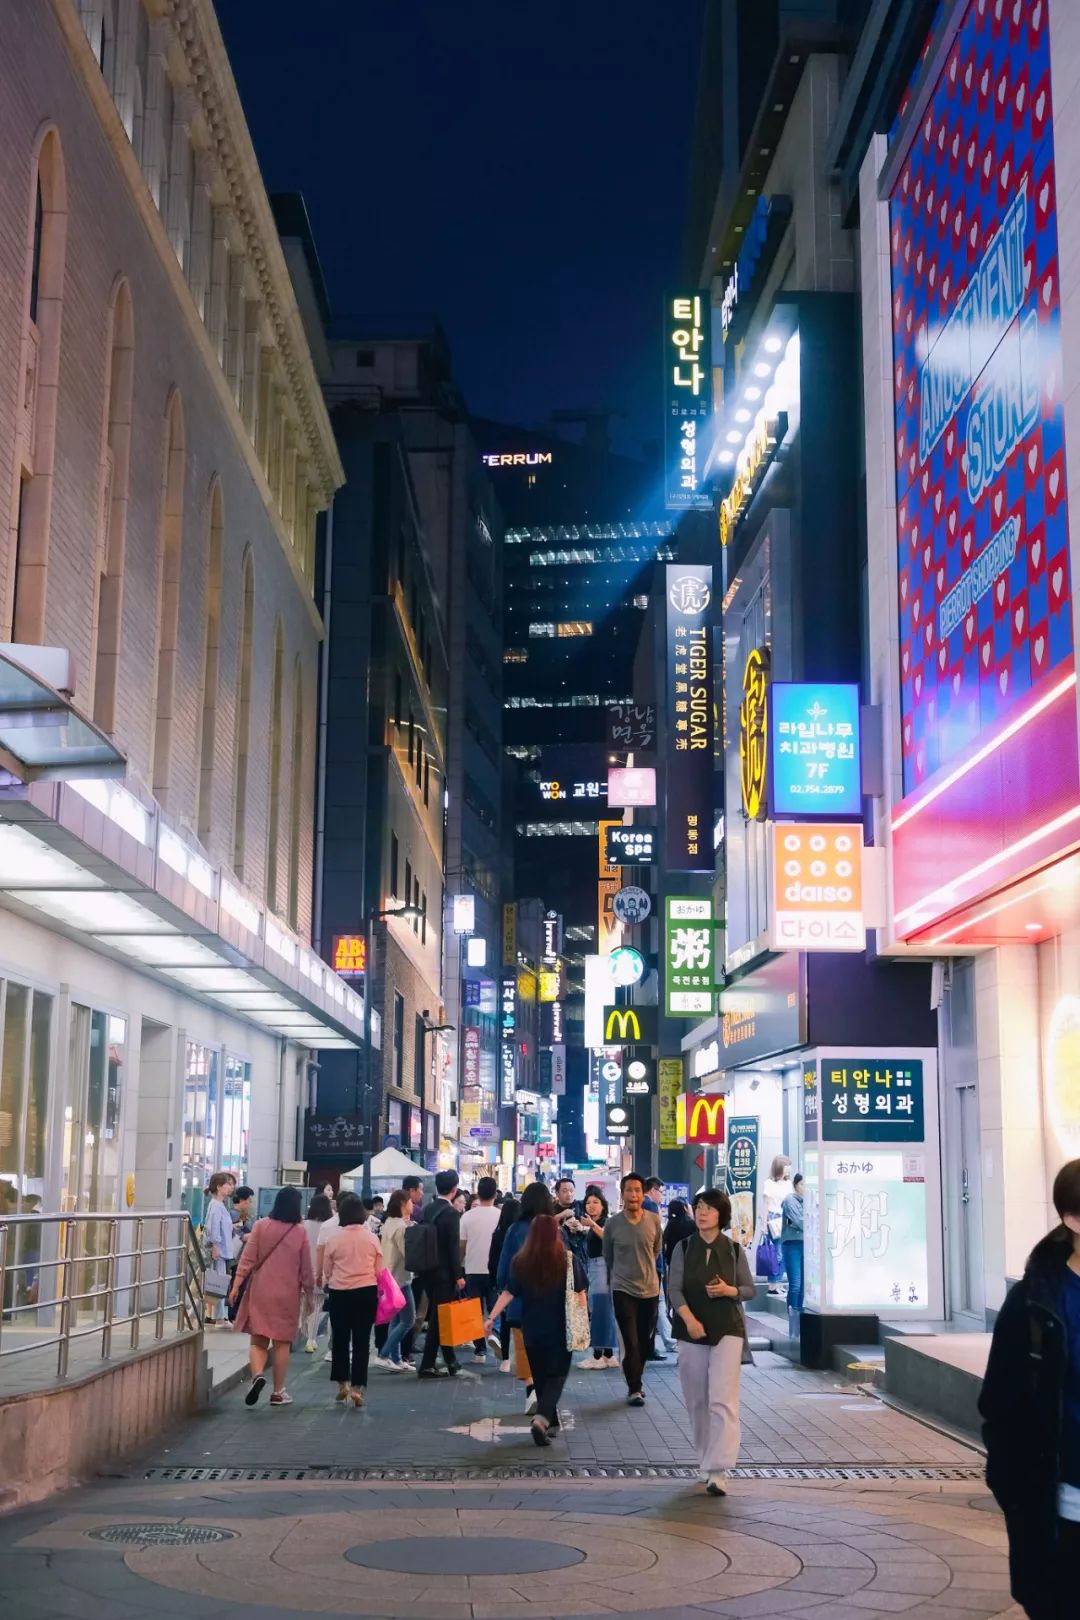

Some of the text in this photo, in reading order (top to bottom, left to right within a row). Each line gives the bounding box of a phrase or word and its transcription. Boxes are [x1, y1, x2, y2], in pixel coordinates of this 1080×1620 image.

[672, 295, 705, 396] 티안나
[680, 420, 698, 491] 성형외과
[970, 516, 1016, 604] SHOPPING
[689, 626, 708, 751] TIGER SUGAR
[609, 705, 655, 724] 강남
[612, 723, 655, 747] 면옥
[805, 762, 829, 779] 7F
[540, 781, 560, 791] KYO
[542, 790, 567, 800] WON
[611, 831, 653, 843] Korea
[624, 844, 653, 856] Spa
[784, 881, 853, 903] daiso
[676, 904, 705, 915] おかゆ
[781, 919, 857, 939] 다이소
[670, 927, 712, 970] 粥
[830, 1068, 893, 1089] 티안나
[831, 1092, 914, 1115] 성형외과
[836, 1160, 874, 1174] おかゆ
